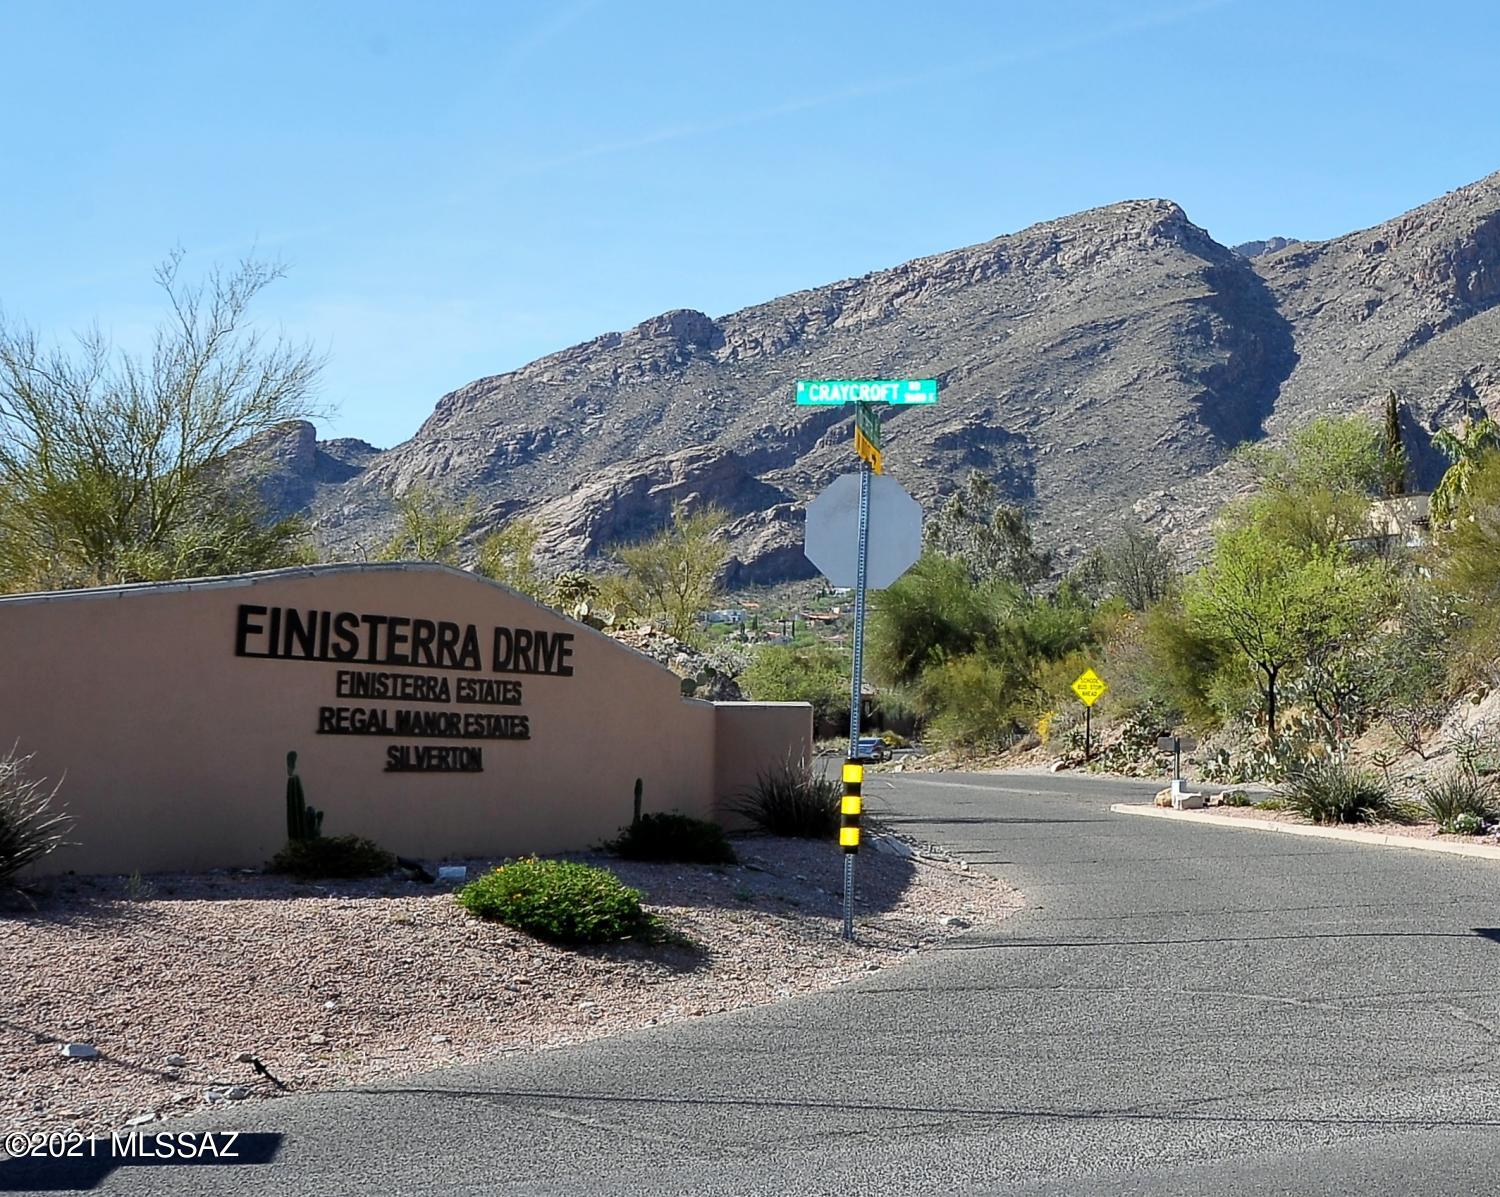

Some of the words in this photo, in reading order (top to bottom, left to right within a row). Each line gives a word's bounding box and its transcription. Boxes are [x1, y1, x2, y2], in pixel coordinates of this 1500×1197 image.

[809, 383, 900, 401] CRAYCROFT
[235, 604, 482, 671] FINISTERRA
[492, 626, 576, 677] DRIVE
[336, 669, 451, 703] FINISTERRA
[456, 678, 523, 705] ESTATES
[318, 706, 394, 735] REGAL
[395, 709, 462, 738] MANOR
[463, 713, 530, 740] ESTATES
[384, 745, 484, 773] SILVERTON
